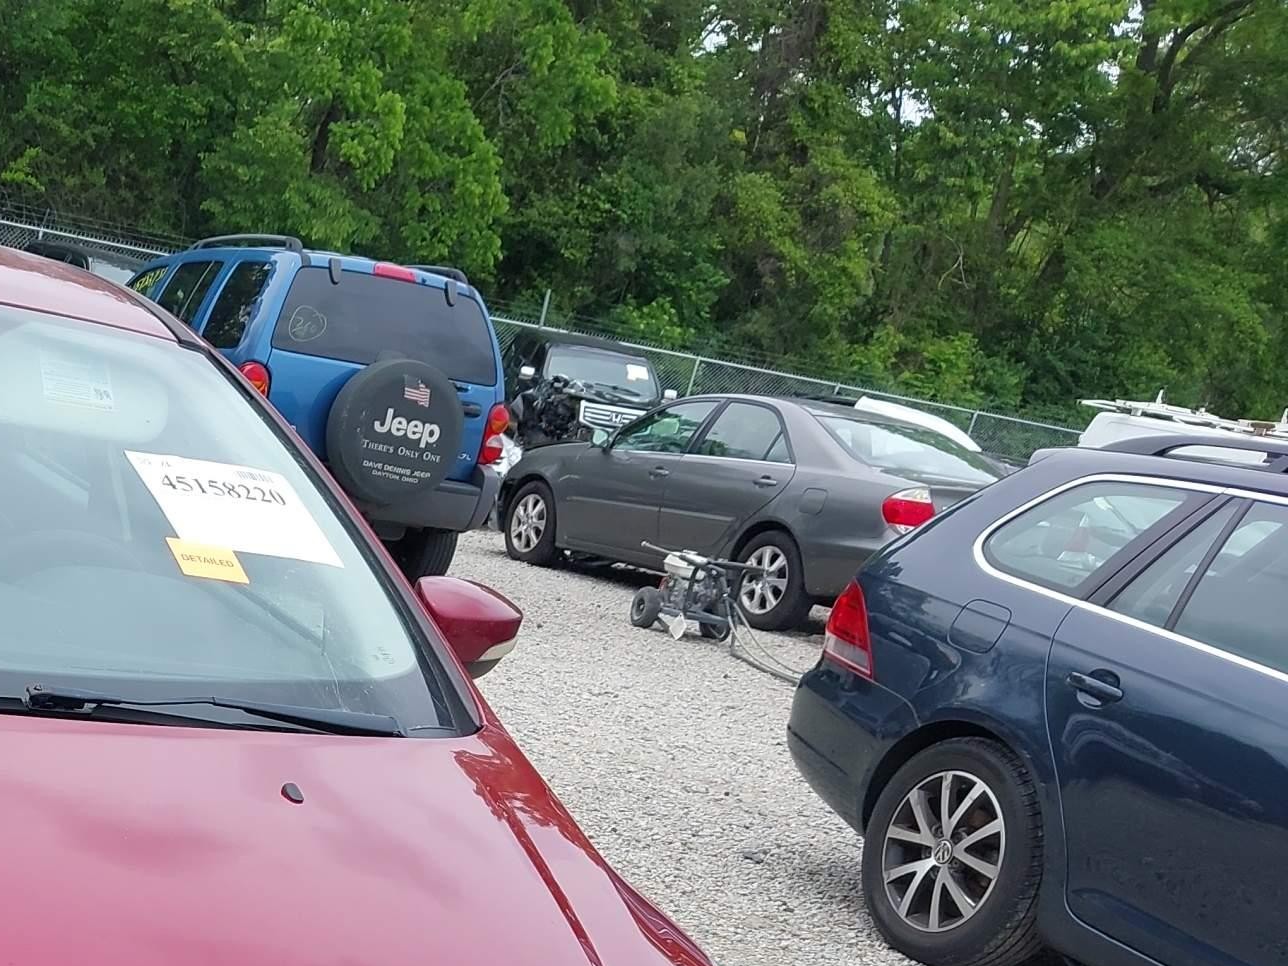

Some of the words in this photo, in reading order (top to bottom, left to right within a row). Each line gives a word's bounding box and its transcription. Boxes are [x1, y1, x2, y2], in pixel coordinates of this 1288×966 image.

[374, 408, 441, 449] Jeep
[398, 447, 420, 458] ONLY
[423, 451, 441, 463] ONE
[363, 460, 383, 469] DAVE
[161, 474, 287, 507] 45158220
[180, 552, 235, 569] DETAILED
